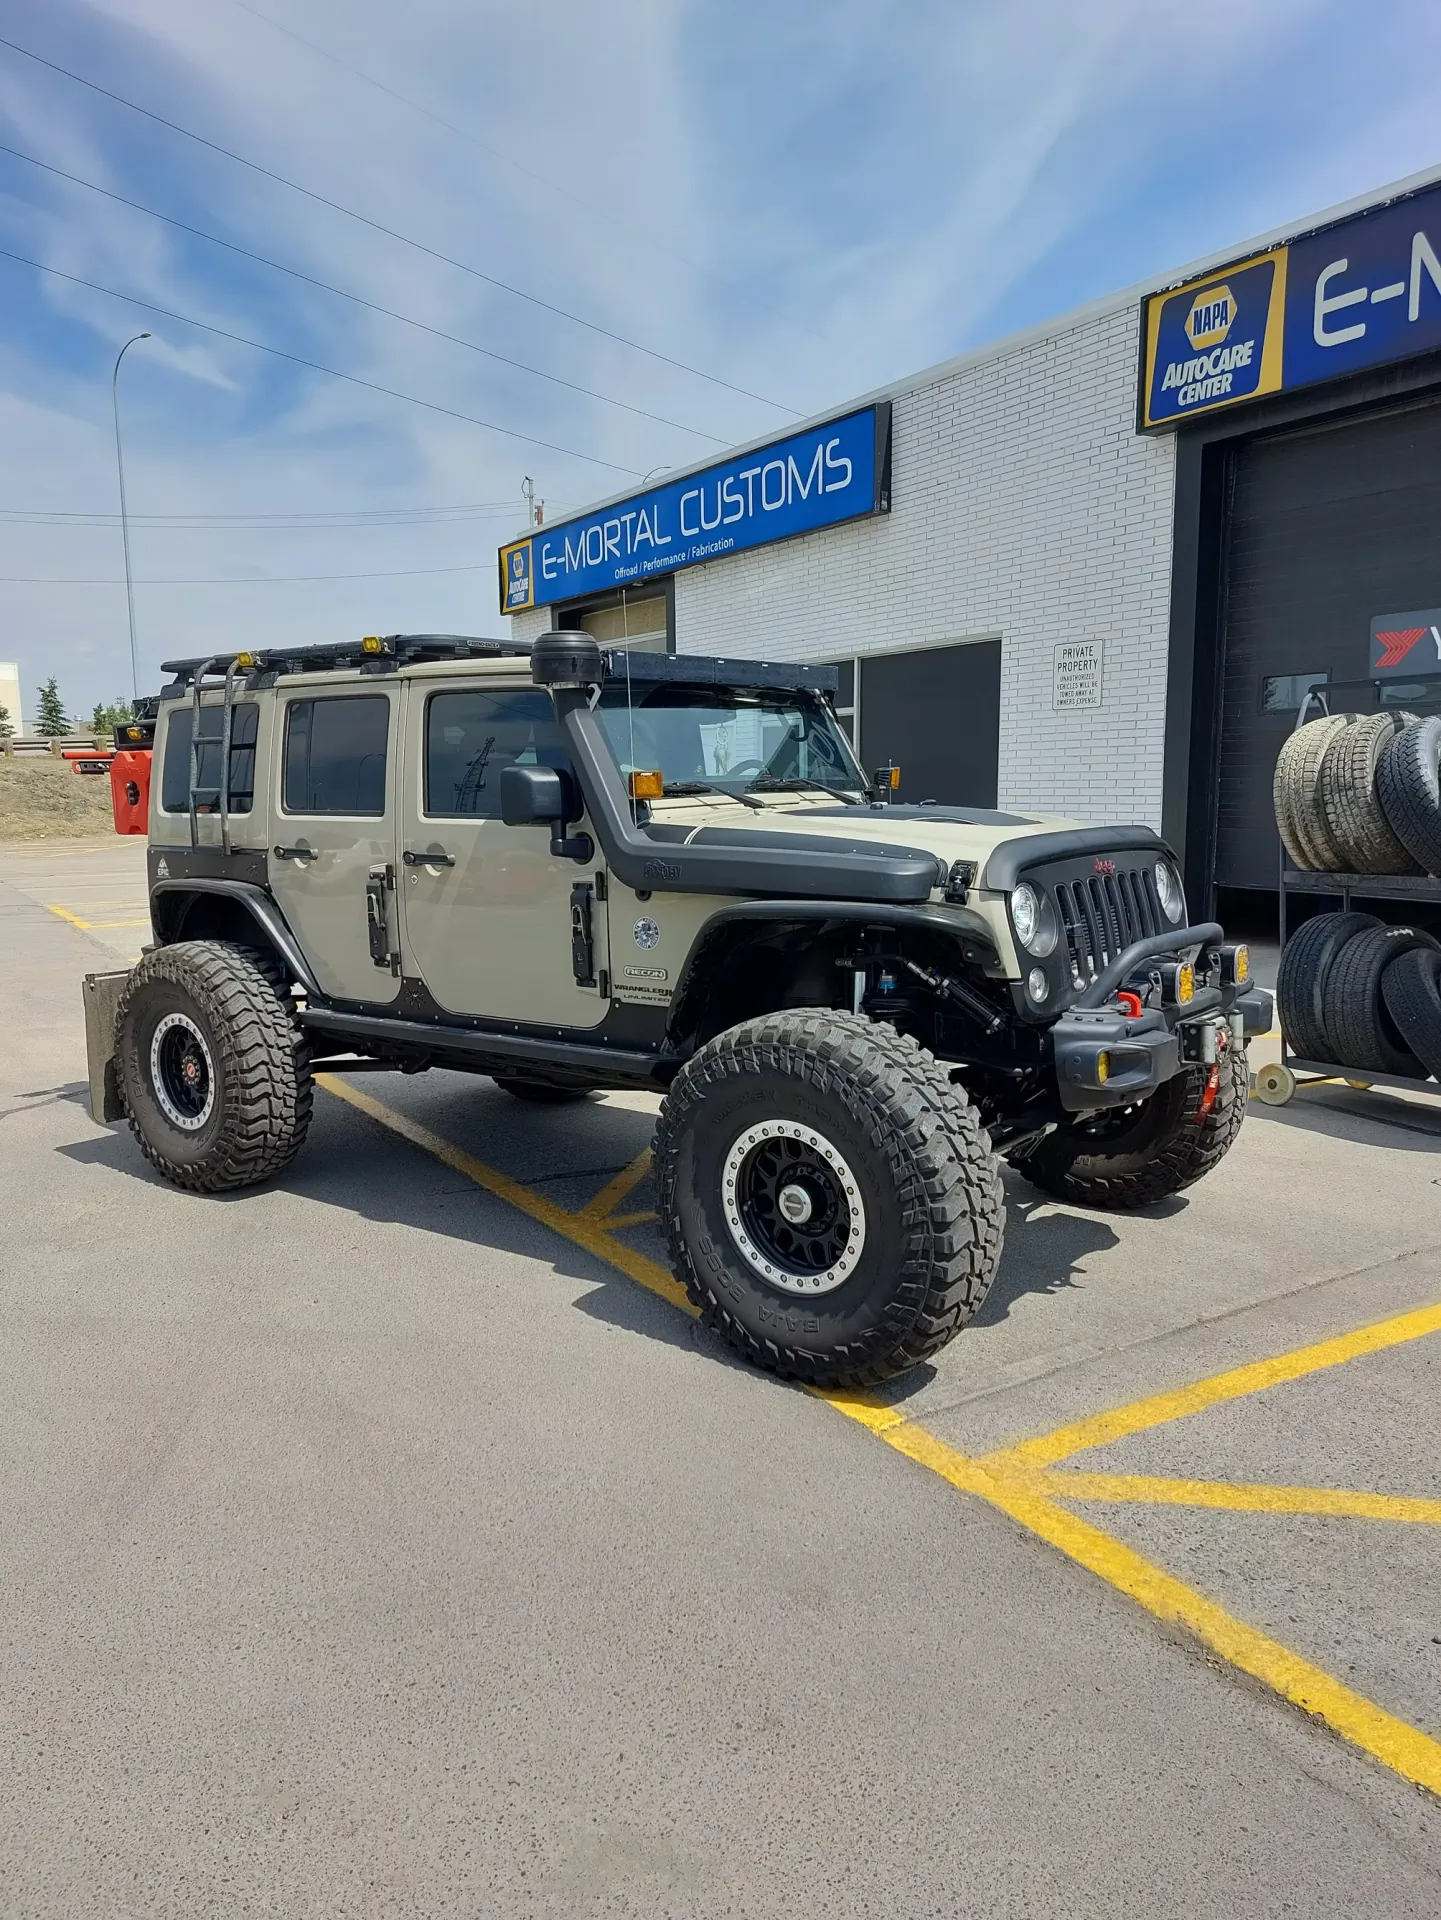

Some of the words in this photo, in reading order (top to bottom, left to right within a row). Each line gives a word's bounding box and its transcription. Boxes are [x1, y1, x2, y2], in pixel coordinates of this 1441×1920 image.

[1192, 300, 1229, 336] NAPA
[1161, 340, 1254, 391] AUTOCARE
[1178, 373, 1232, 406] CENTER
[543, 505, 672, 579] E-MORTAL
[681, 439, 852, 536] CUSTOMS
[615, 563, 638, 579] Offroad
[643, 552, 686, 571] Performance
[692, 538, 734, 558] Fabrication
[1062, 645, 1094, 659] PRIVATE
[1057, 658, 1098, 673] PROPERTY
[1060, 673, 1094, 682] UNAUTHORIZED
[1057, 682, 1078, 690] VEHICLES
[1060, 690, 1074, 698] TOWED
[1094, 858, 1115, 874] Jeep
[626, 968, 663, 977] RECON
[614, 984, 664, 994] WRANGLER
[623, 994, 670, 1003] UNLIMITED
[697, 1234, 746, 1303] BOSS
[756, 1303, 821, 1334] BAJA
